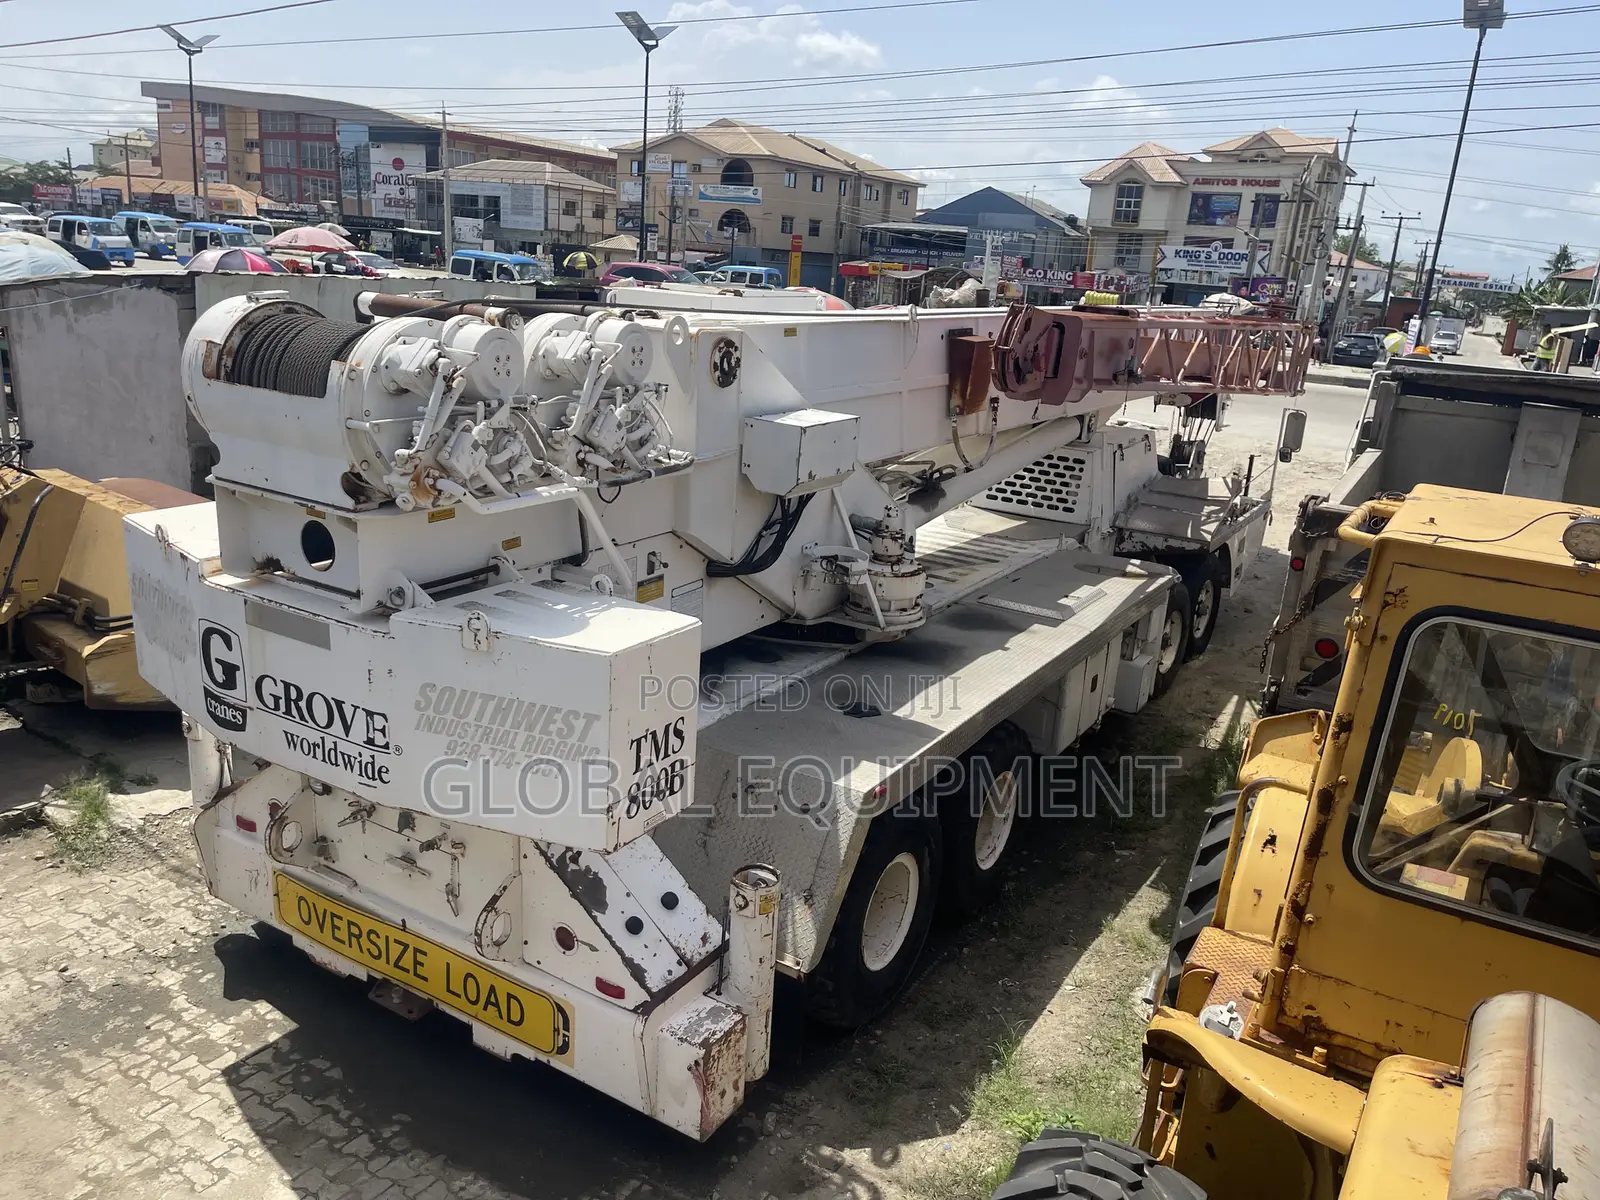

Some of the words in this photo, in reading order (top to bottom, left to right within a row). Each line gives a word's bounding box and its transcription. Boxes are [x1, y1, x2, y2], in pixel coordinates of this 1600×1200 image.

[1241, 178, 1281, 188] HOUSE
[1046, 270, 1073, 281] KING
[1174, 249, 1213, 260] KING'S
[1218, 251, 1249, 262] DOOR
[1436, 278, 1480, 289] TREASURE
[1483, 283, 1514, 292] ESTATE
[201, 626, 241, 692] G
[206, 697, 243, 725] cranes
[254, 673, 391, 751] GROVE
[414, 681, 602, 745] SOUTHWEST
[282, 729, 391, 785] worldwide
[414, 713, 520, 752] INDUSTRIAL
[520, 734, 601, 766] RIGGING
[629, 716, 685, 776] TMS
[626, 758, 685, 820] 800B
[297, 895, 429, 983] OVERSIZE
[445, 961, 526, 1028] LOAD
